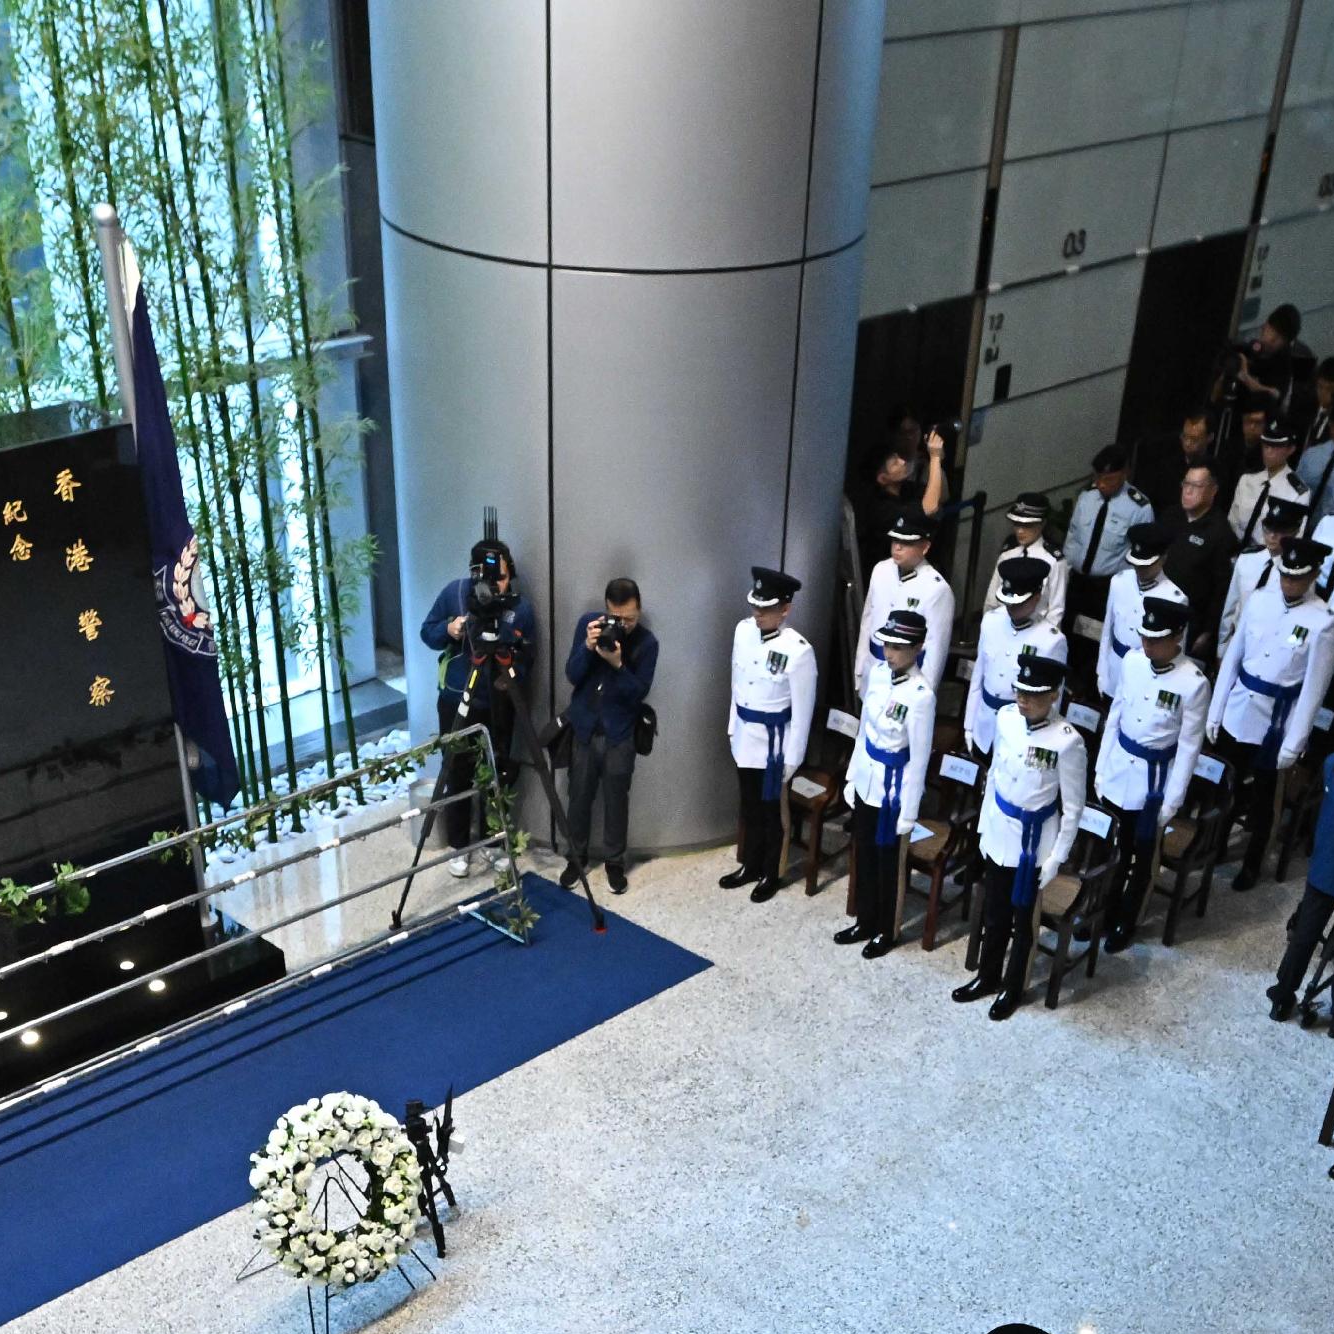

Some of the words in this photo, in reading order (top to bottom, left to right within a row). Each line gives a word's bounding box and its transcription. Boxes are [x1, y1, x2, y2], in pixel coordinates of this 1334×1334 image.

[2, 500, 35, 562] 紀念
[54, 468, 114, 705] 香港警察
